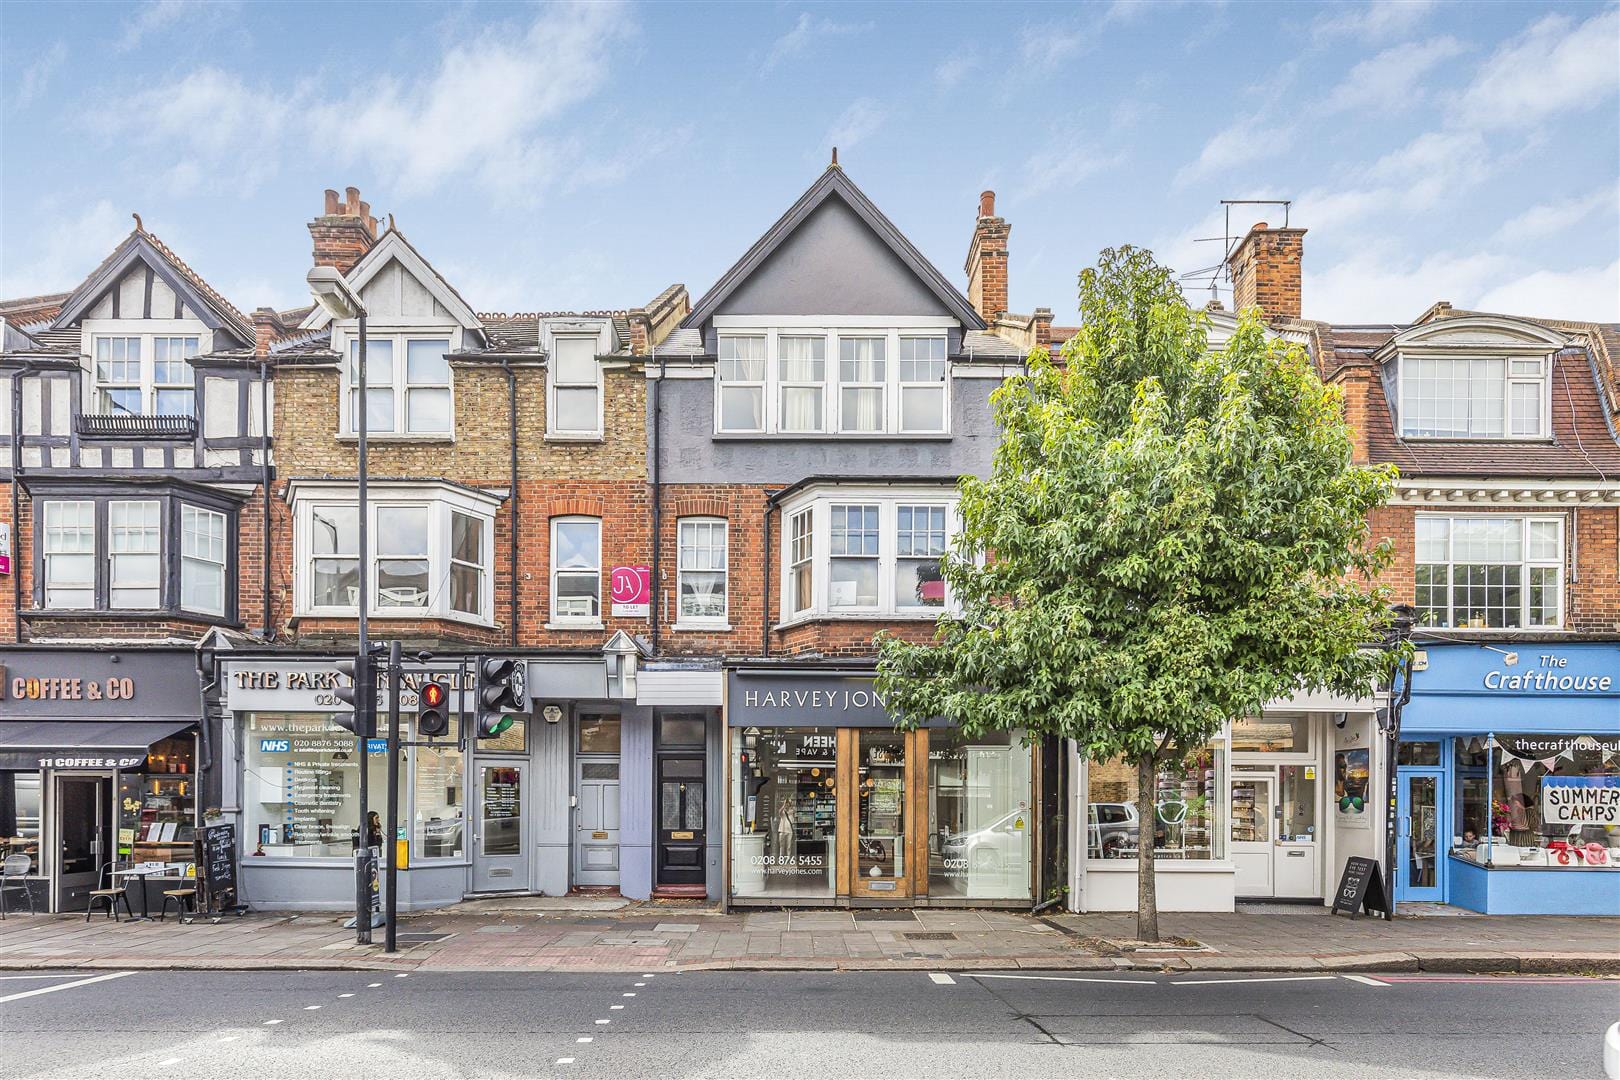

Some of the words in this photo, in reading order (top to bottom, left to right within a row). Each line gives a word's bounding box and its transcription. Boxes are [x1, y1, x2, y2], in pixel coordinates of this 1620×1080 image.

[613, 576, 633, 594] JA
[1540, 655, 1568, 667] The
[12, 677, 82, 700] COFFEE
[87, 681, 102, 700] &
[106, 677, 134, 700] CO
[234, 671, 279, 689] THE
[285, 671, 341, 690] PARK
[1484, 670, 1612, 691] Crafthouse
[745, 690, 838, 707] HARVEY
[843, 690, 890, 711] JON
[262, 741, 289, 752] NHS
[294, 740, 309, 748] 020
[311, 740, 331, 748] 8876
[333, 740, 354, 748] 5088
[367, 743, 388, 751] RIVAT
[38, 758, 52, 768] 11
[55, 758, 104, 768] COFFEE
[105, 758, 118, 768] &
[119, 758, 141, 768] CO
[1549, 789, 1620, 806] SUMMER
[1558, 805, 1617, 822] CAMPS
[751, 855, 776, 865] 0208
[778, 855, 796, 865] 876
[798, 855, 823, 865] 5455
